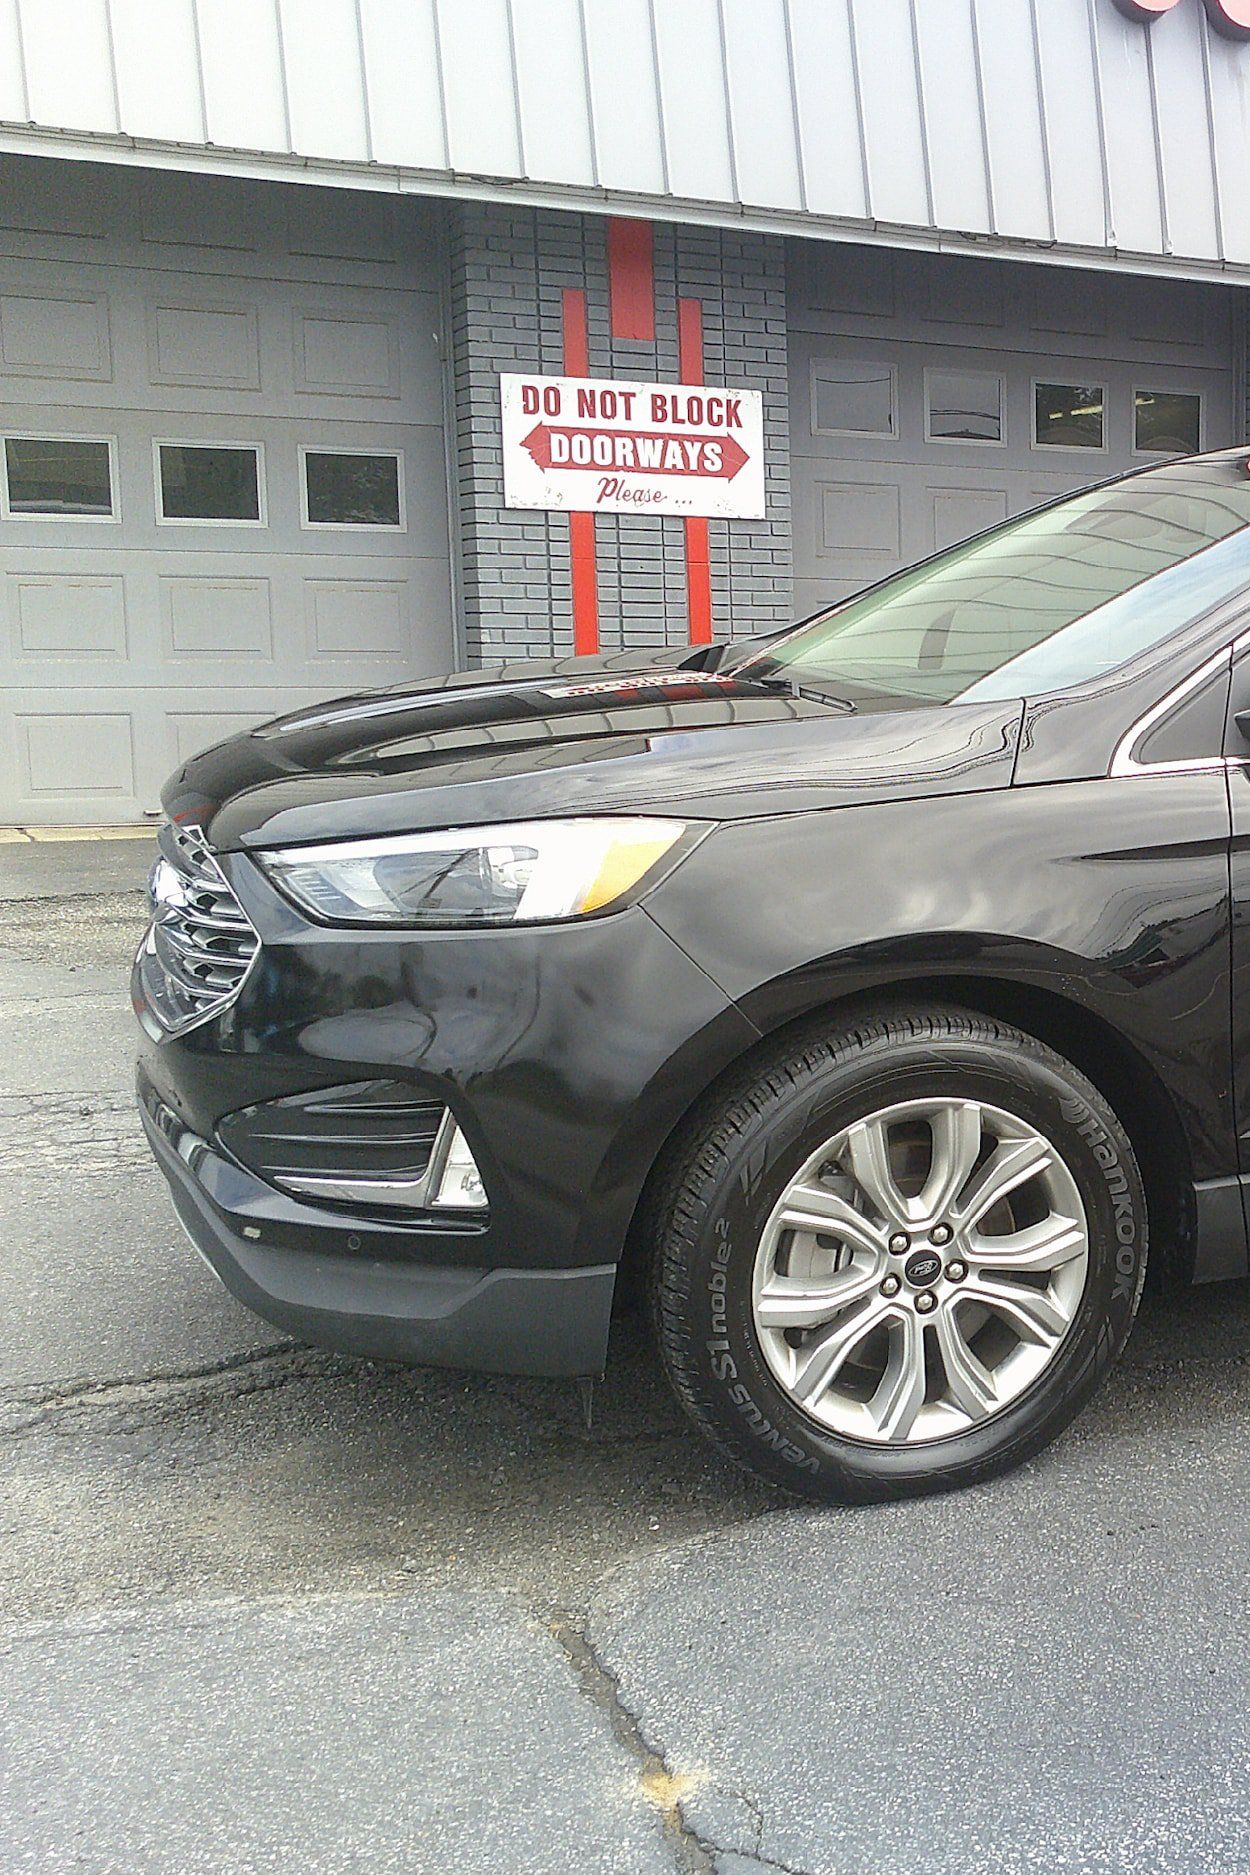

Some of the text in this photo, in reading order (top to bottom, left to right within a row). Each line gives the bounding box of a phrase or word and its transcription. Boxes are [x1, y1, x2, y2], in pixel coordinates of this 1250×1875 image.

[521, 385, 743, 428] DO NOT BLOCK
[550, 432, 723, 472] DOORWAYS
[597, 477, 667, 504] Please
[1075, 1118, 1135, 1300] Hankook
[706, 1339, 738, 1381] S1
